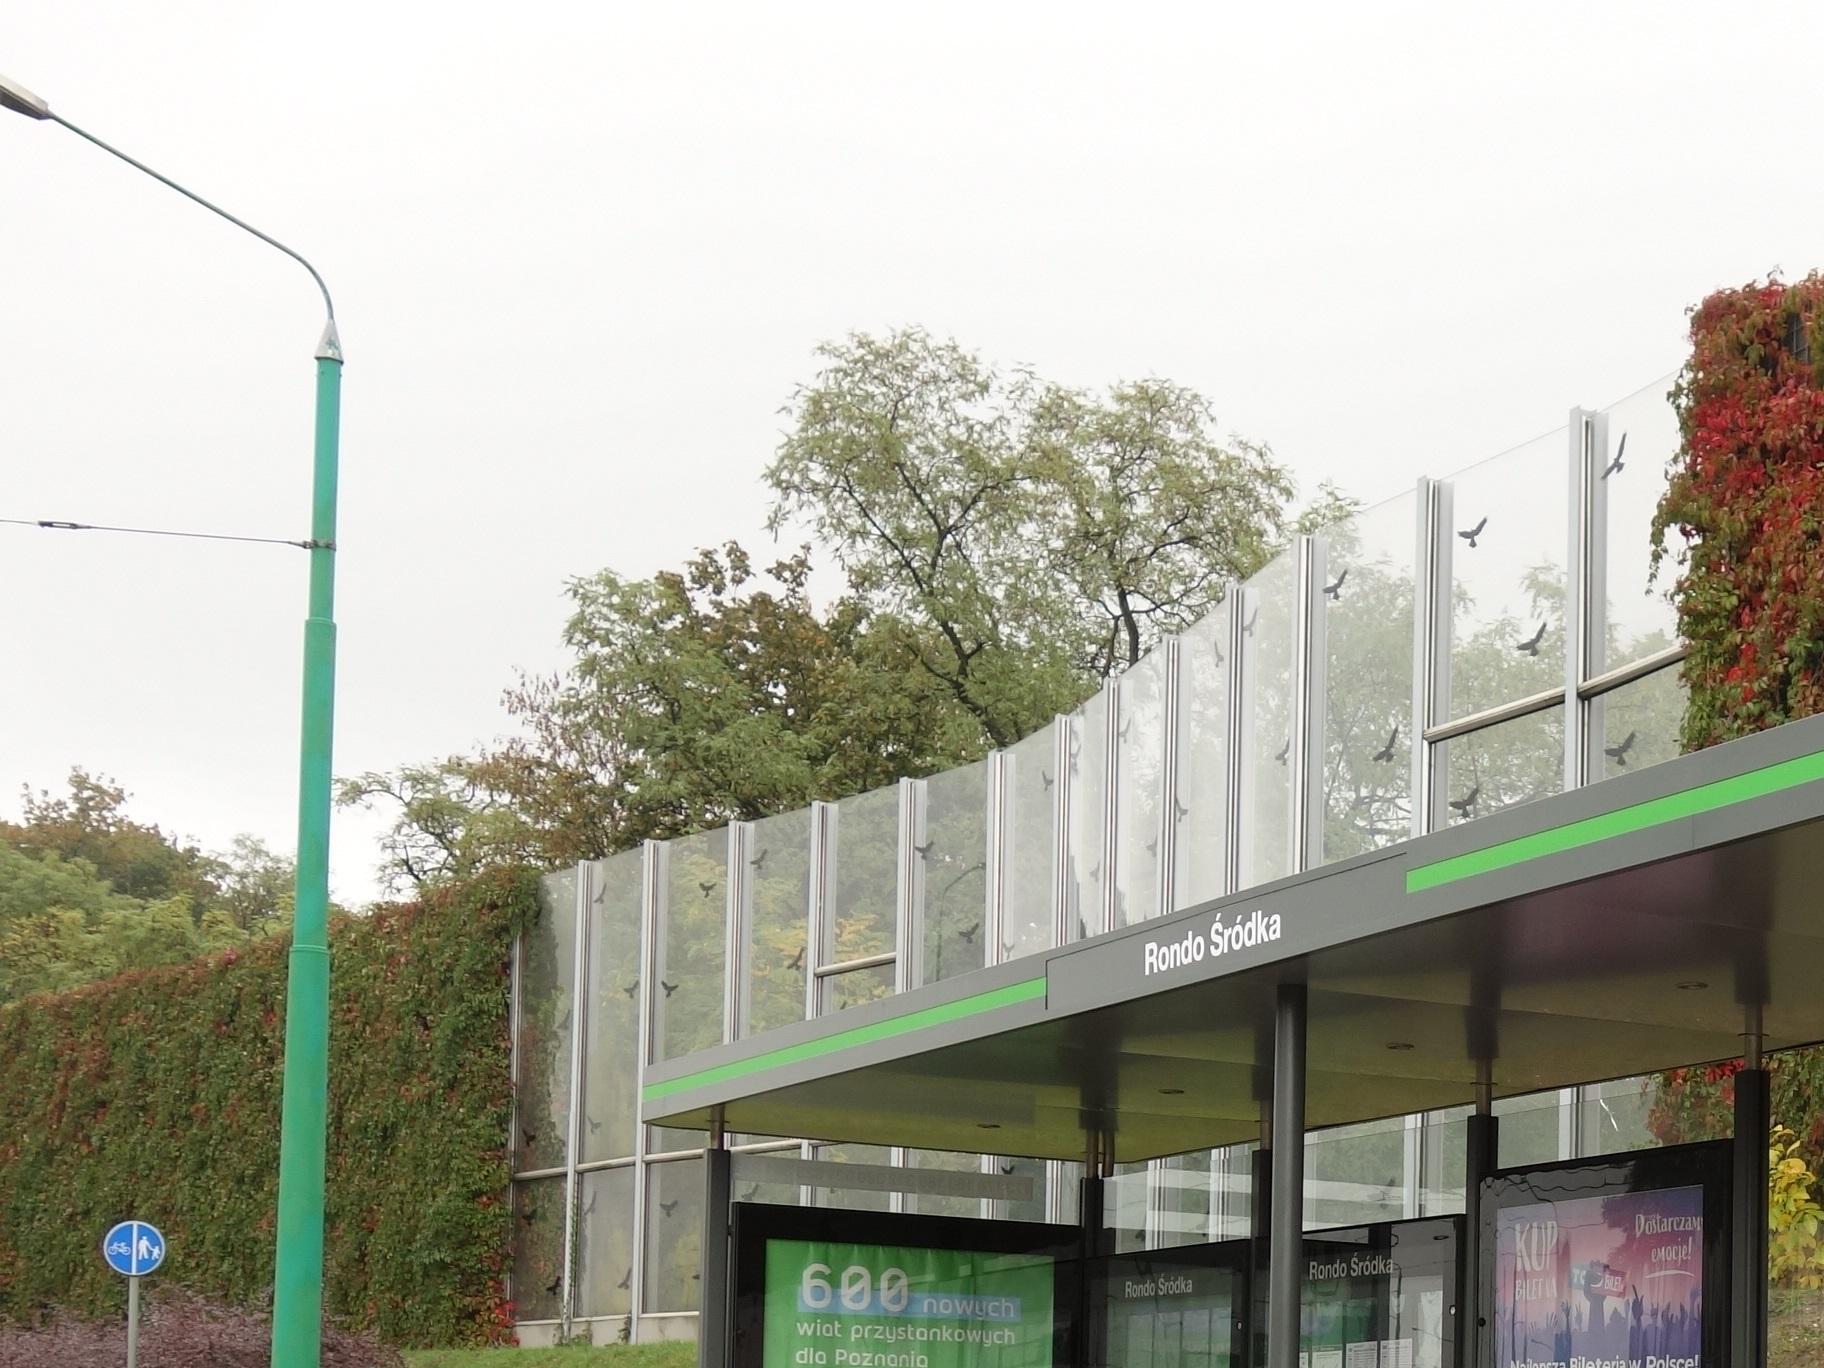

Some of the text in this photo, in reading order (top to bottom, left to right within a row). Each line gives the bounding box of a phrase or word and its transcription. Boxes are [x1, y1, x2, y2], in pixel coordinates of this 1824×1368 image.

[1144, 910, 1281, 975] Rondo Śródka
[1515, 1221, 1558, 1272] KUP
[1309, 1252, 1393, 1281] Rondo Śródka
[802, 1263, 1015, 1320] 600 nowych
[1124, 1273, 1193, 1298] Rondo Śródka
[796, 1320, 1016, 1347] wiat przystankowych
[796, 1348, 929, 1368] dla Poznania
